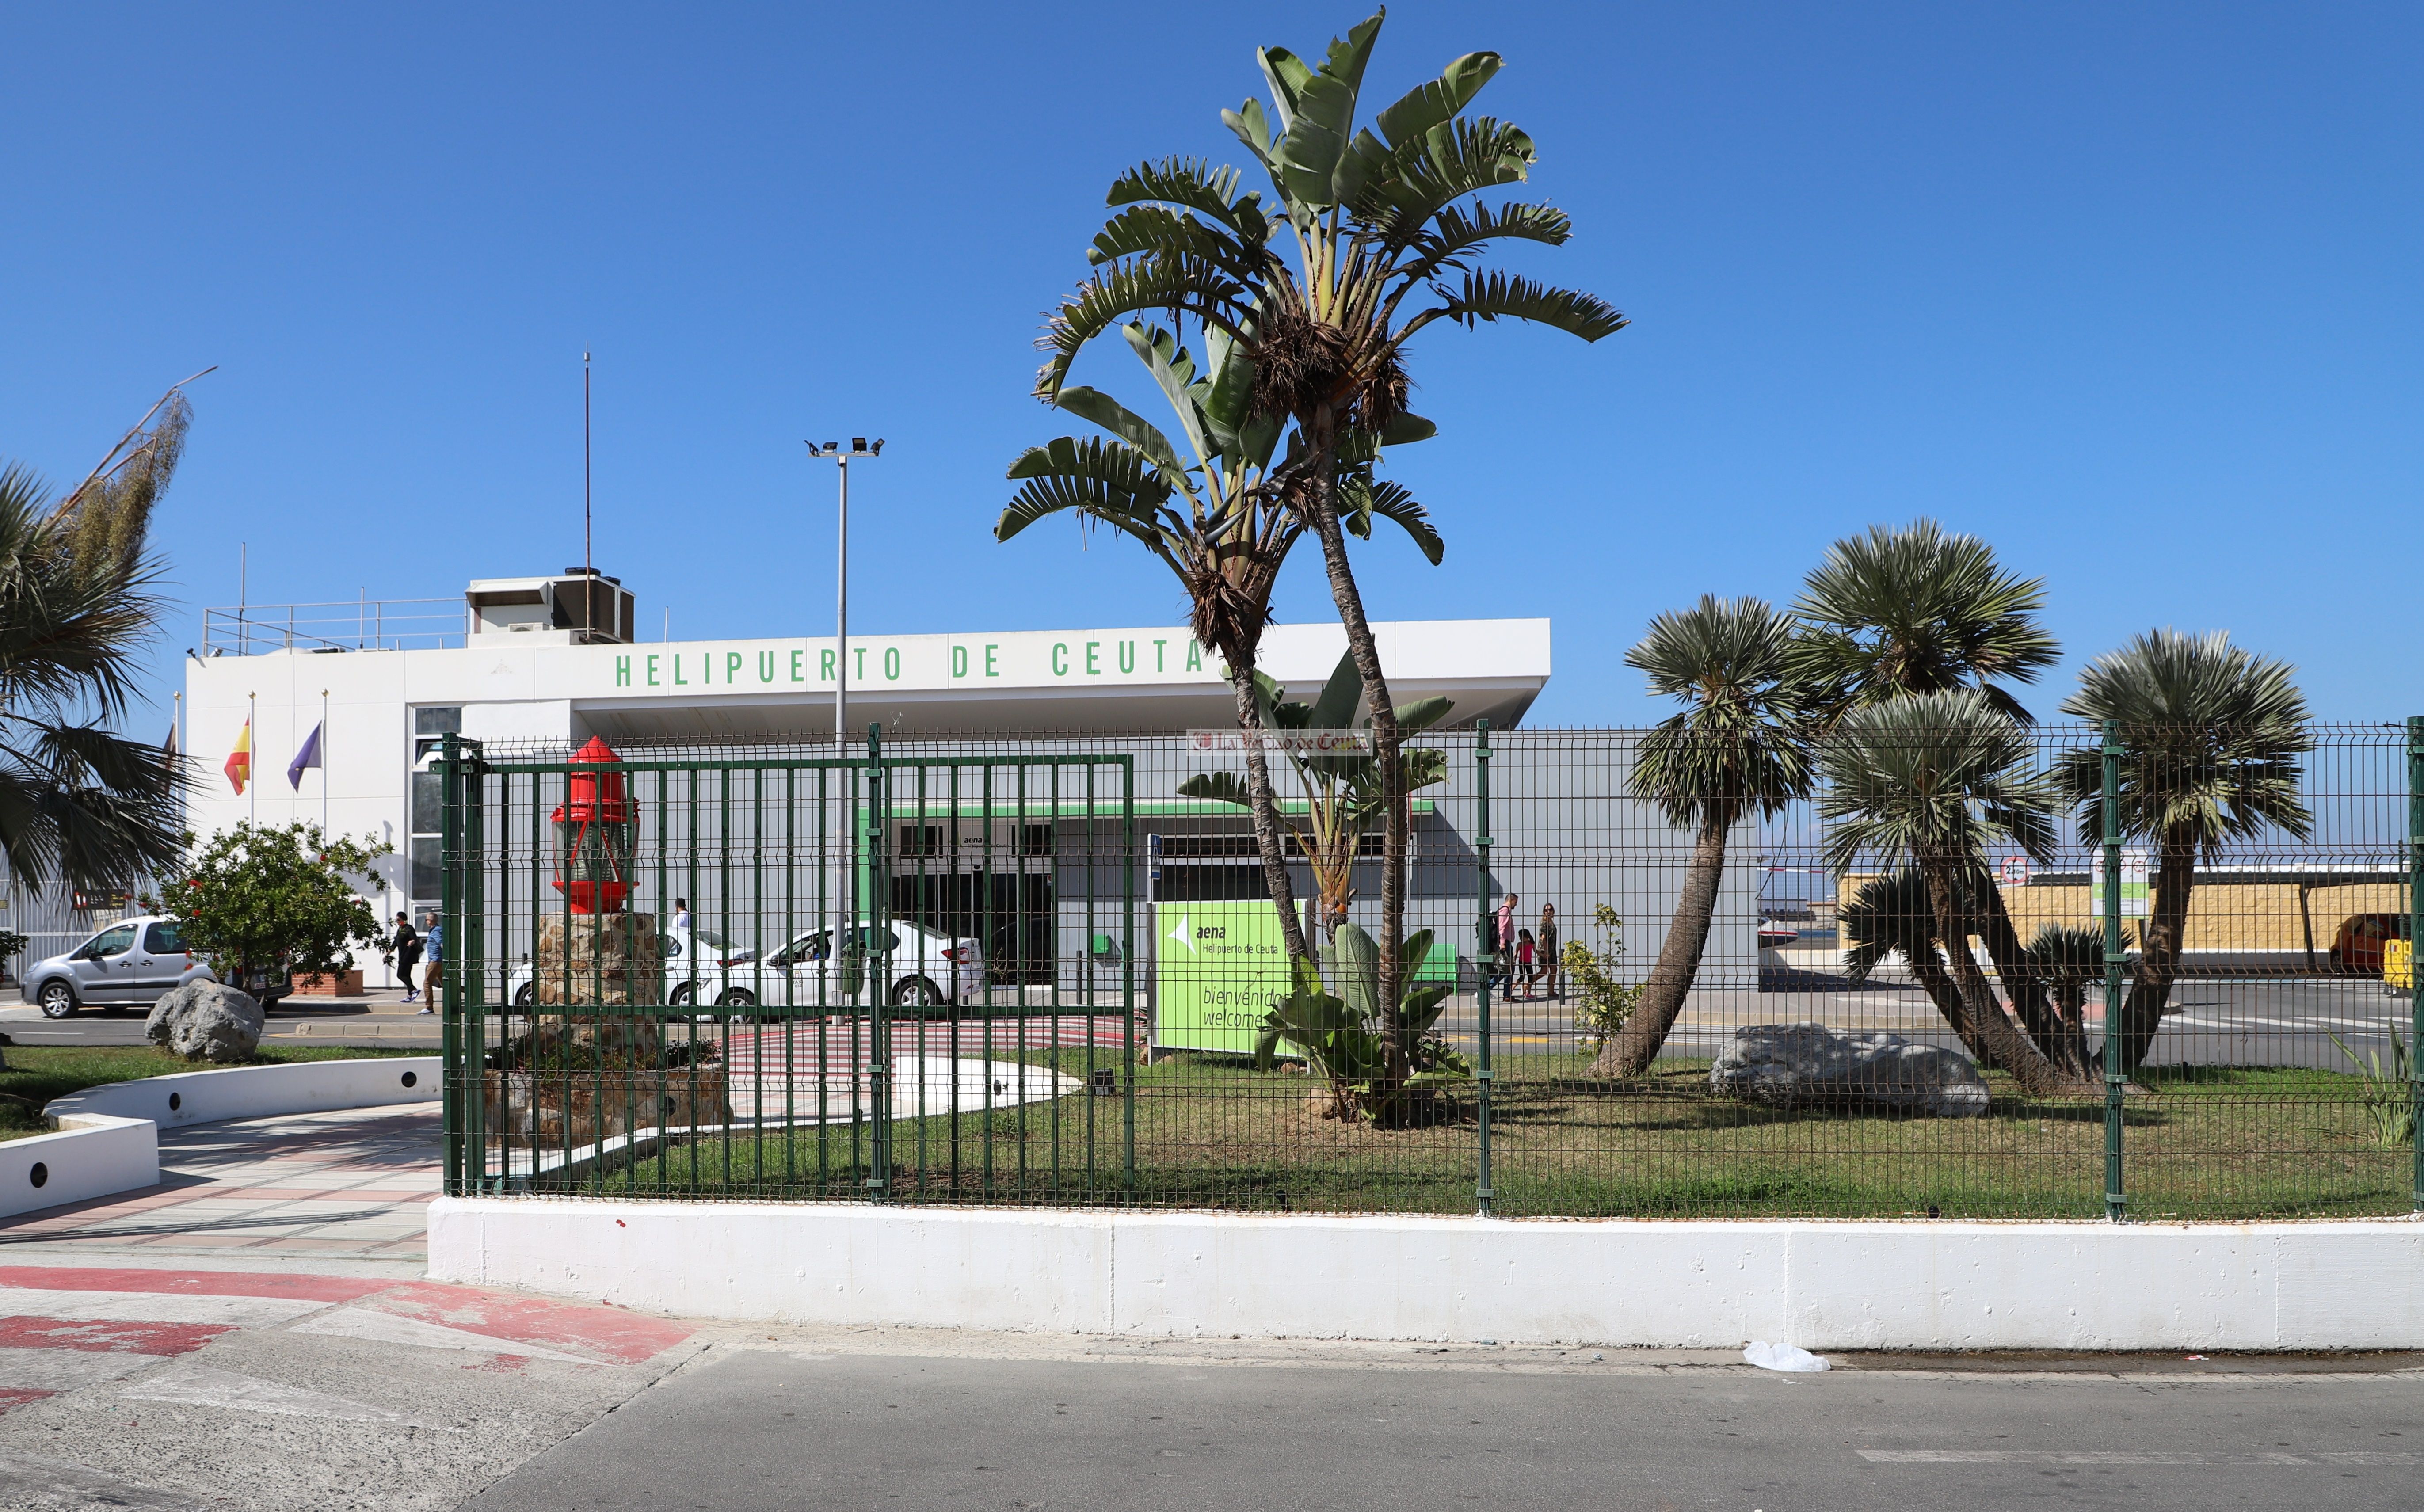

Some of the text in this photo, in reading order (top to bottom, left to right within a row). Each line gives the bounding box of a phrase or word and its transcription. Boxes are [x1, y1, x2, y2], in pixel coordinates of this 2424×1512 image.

[616, 639, 1202, 686] HELIPUERTO DE CEUTA
[1196, 926, 1226, 939] aena
[1203, 943, 1278, 956] Helipuerto de Ceuta
[1203, 986, 1292, 1006] bienvenido
[1204, 1008, 1263, 1028] welcome
